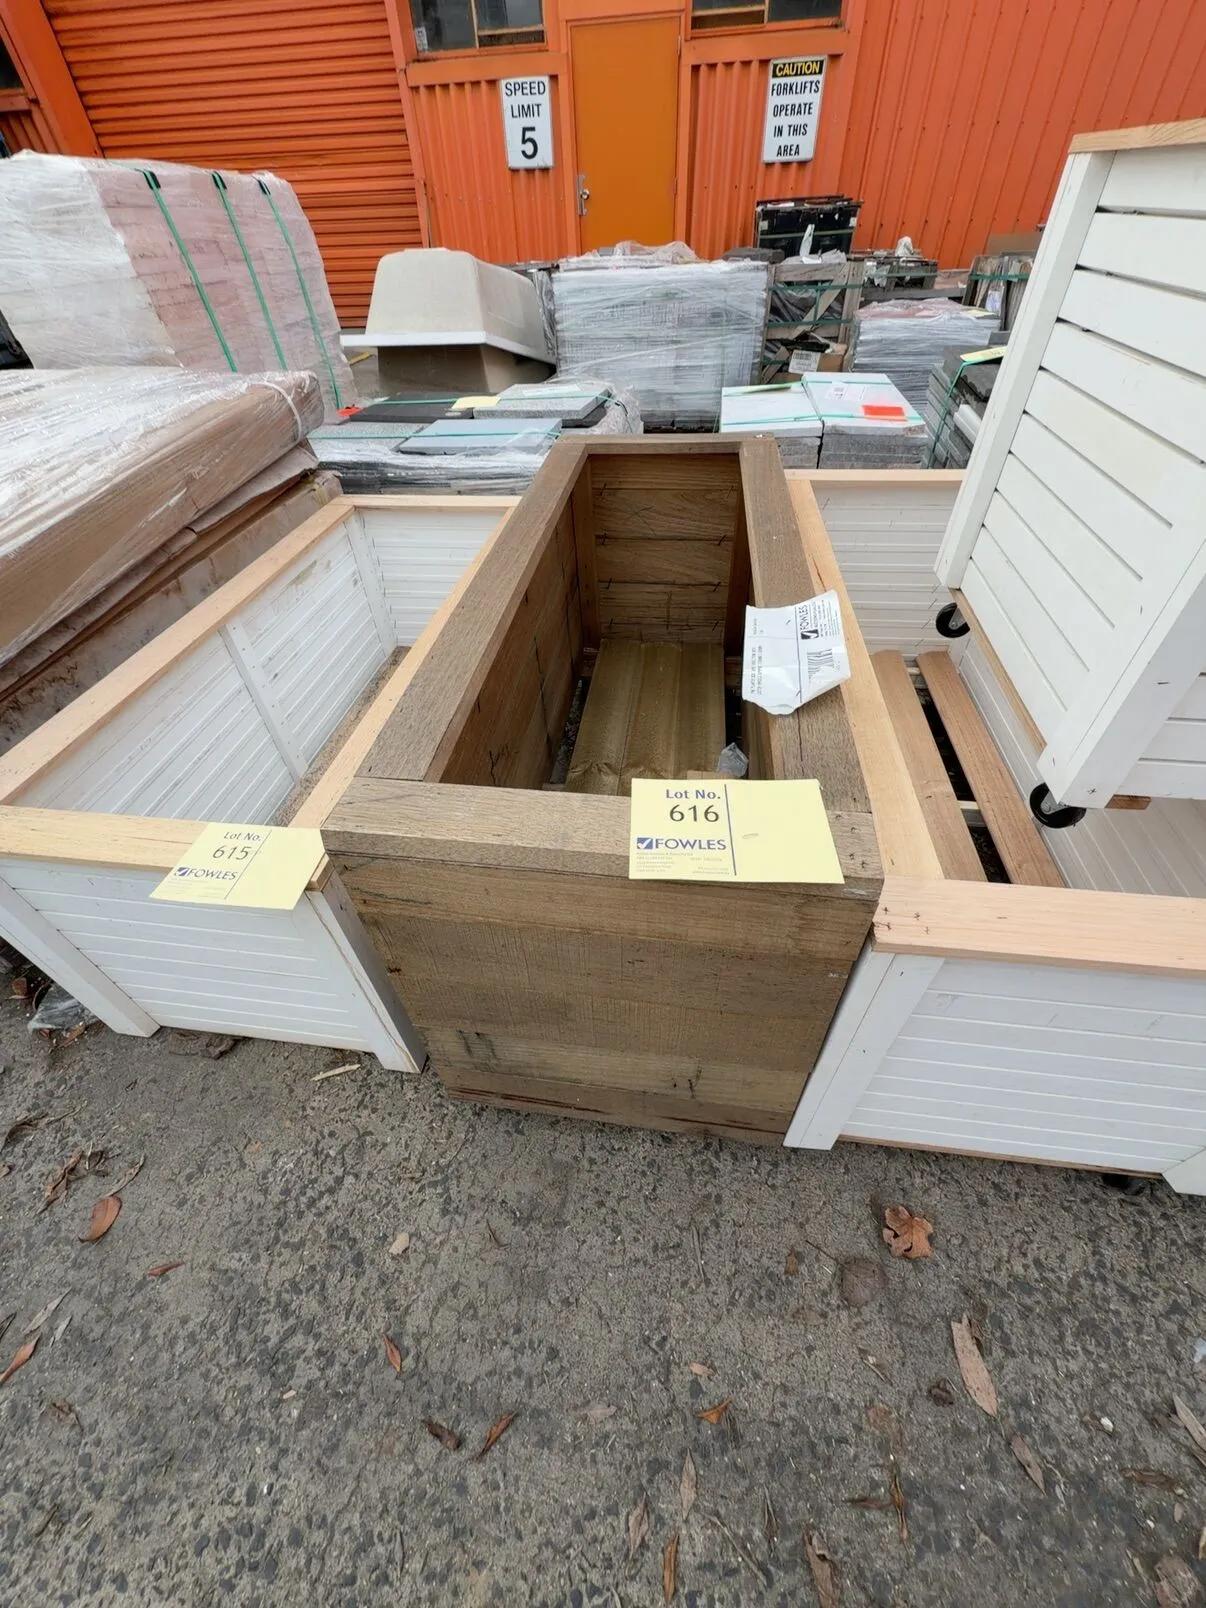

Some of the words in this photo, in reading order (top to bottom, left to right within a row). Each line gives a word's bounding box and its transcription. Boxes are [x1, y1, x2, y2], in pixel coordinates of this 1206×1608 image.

[775, 61, 821, 76] CAUTION
[504, 81, 546, 97] SPEED
[771, 80, 821, 96] FORKLIFTS
[510, 103, 542, 119] LIMIT
[773, 102, 814, 118] OPERATE
[773, 125, 784, 138] IN
[787, 123, 808, 137] THIS
[521, 126, 539, 160] 5
[776, 144, 800, 157] AREA
[798, 604, 810, 630] FOWLES
[665, 788, 690, 800] Lot
[695, 789, 721, 800] No.
[669, 804, 720, 823] 616
[223, 831, 240, 841] Lot
[243, 832, 262, 842] No.
[655, 838, 727, 851] FOWLES
[212, 844, 252, 861] 615
[186, 867, 239, 881] FOWLES
